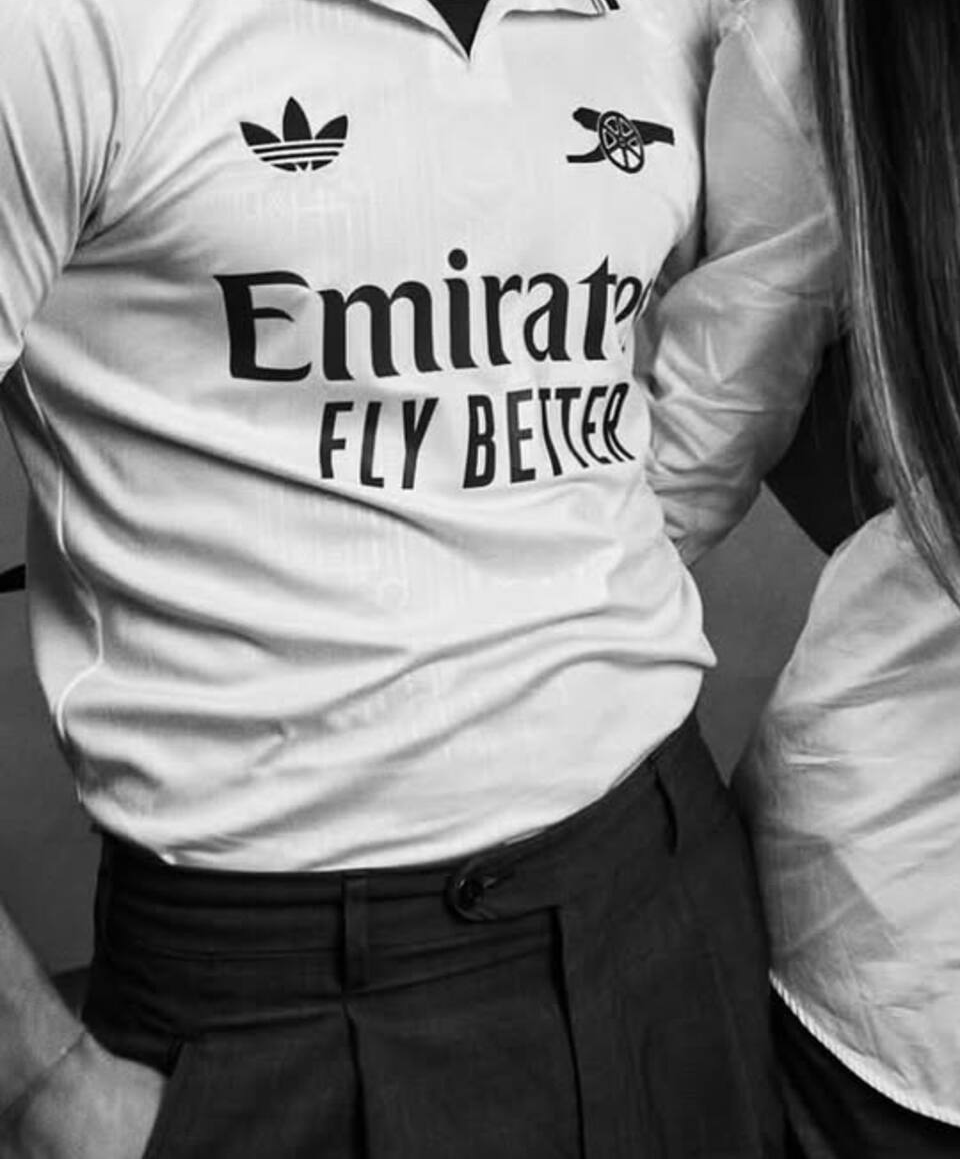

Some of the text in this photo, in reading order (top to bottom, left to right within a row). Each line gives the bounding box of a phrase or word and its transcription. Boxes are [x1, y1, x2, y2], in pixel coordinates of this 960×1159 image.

[213, 248, 652, 381] Emirate
[319, 382, 636, 489] FLY BETTER
